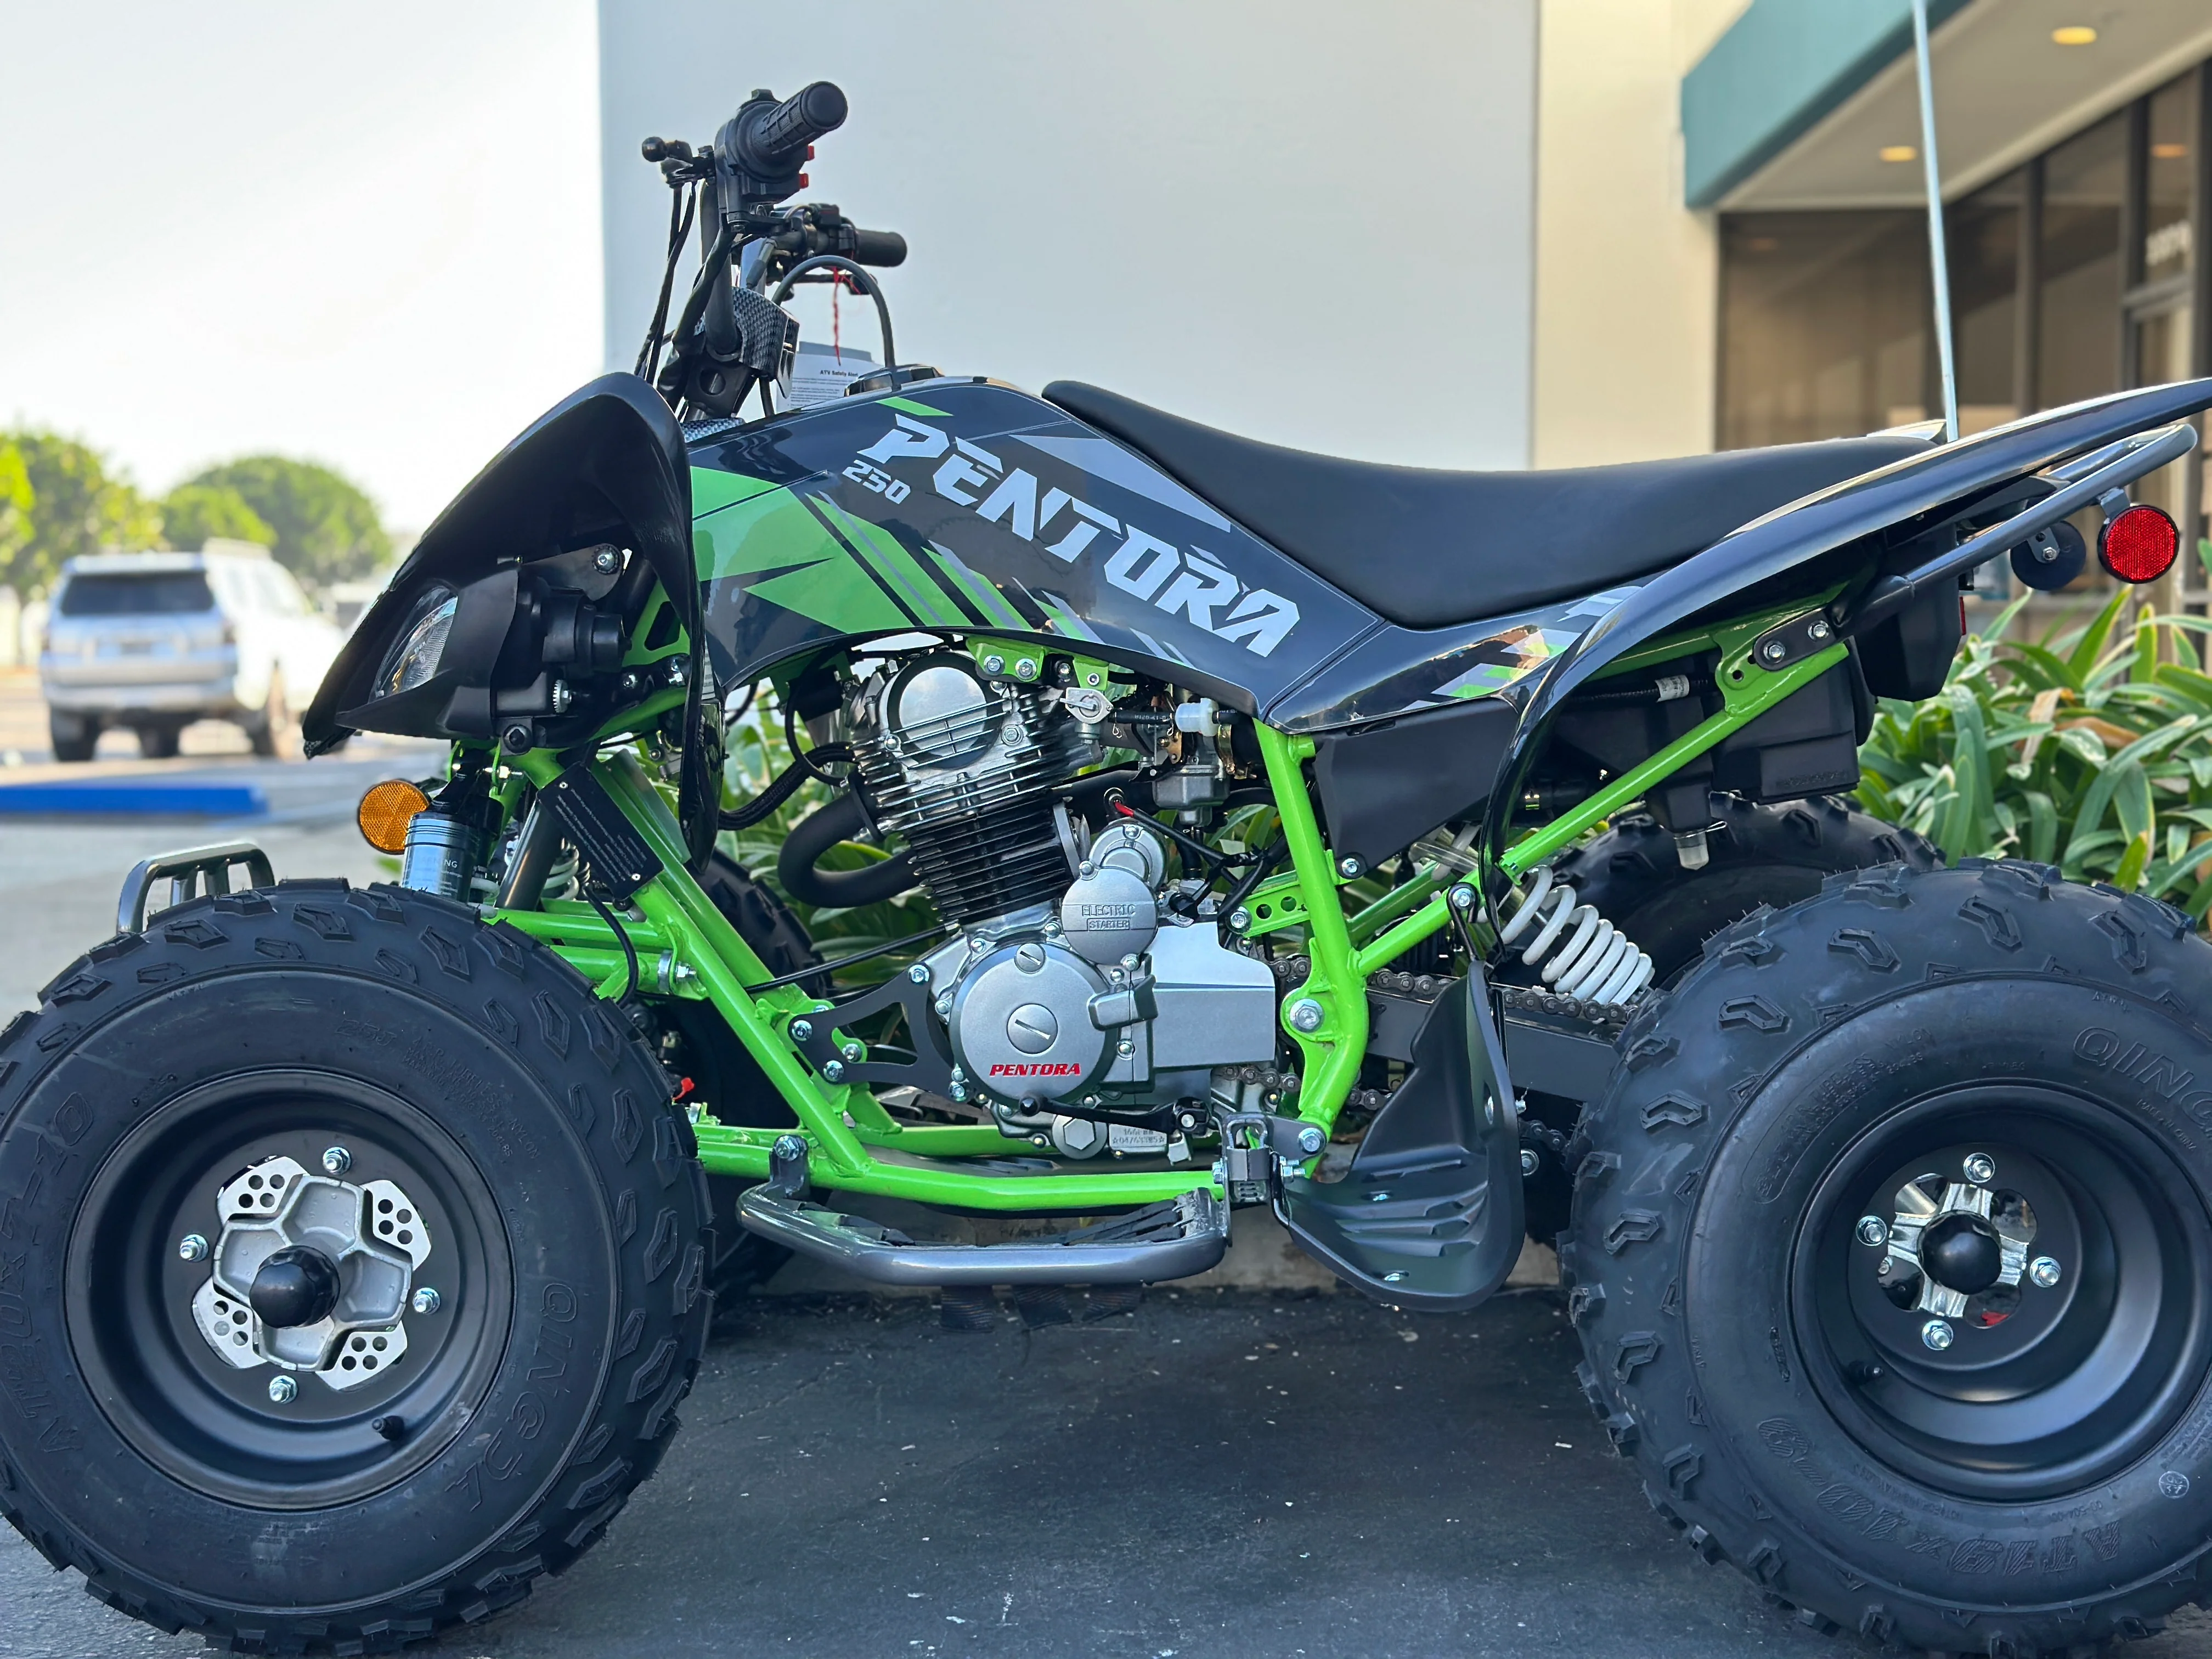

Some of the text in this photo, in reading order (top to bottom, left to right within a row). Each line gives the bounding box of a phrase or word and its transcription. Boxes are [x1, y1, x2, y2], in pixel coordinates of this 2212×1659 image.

[842, 459, 911, 505] 250
[857, 413, 1300, 658] PENTORA
[1081, 904, 1136, 917] ELECTRIC
[1089, 920, 1130, 929] STARTER
[989, 1062, 1081, 1077] PENTORA
[445, 1282, 578, 1513] QINGDA
